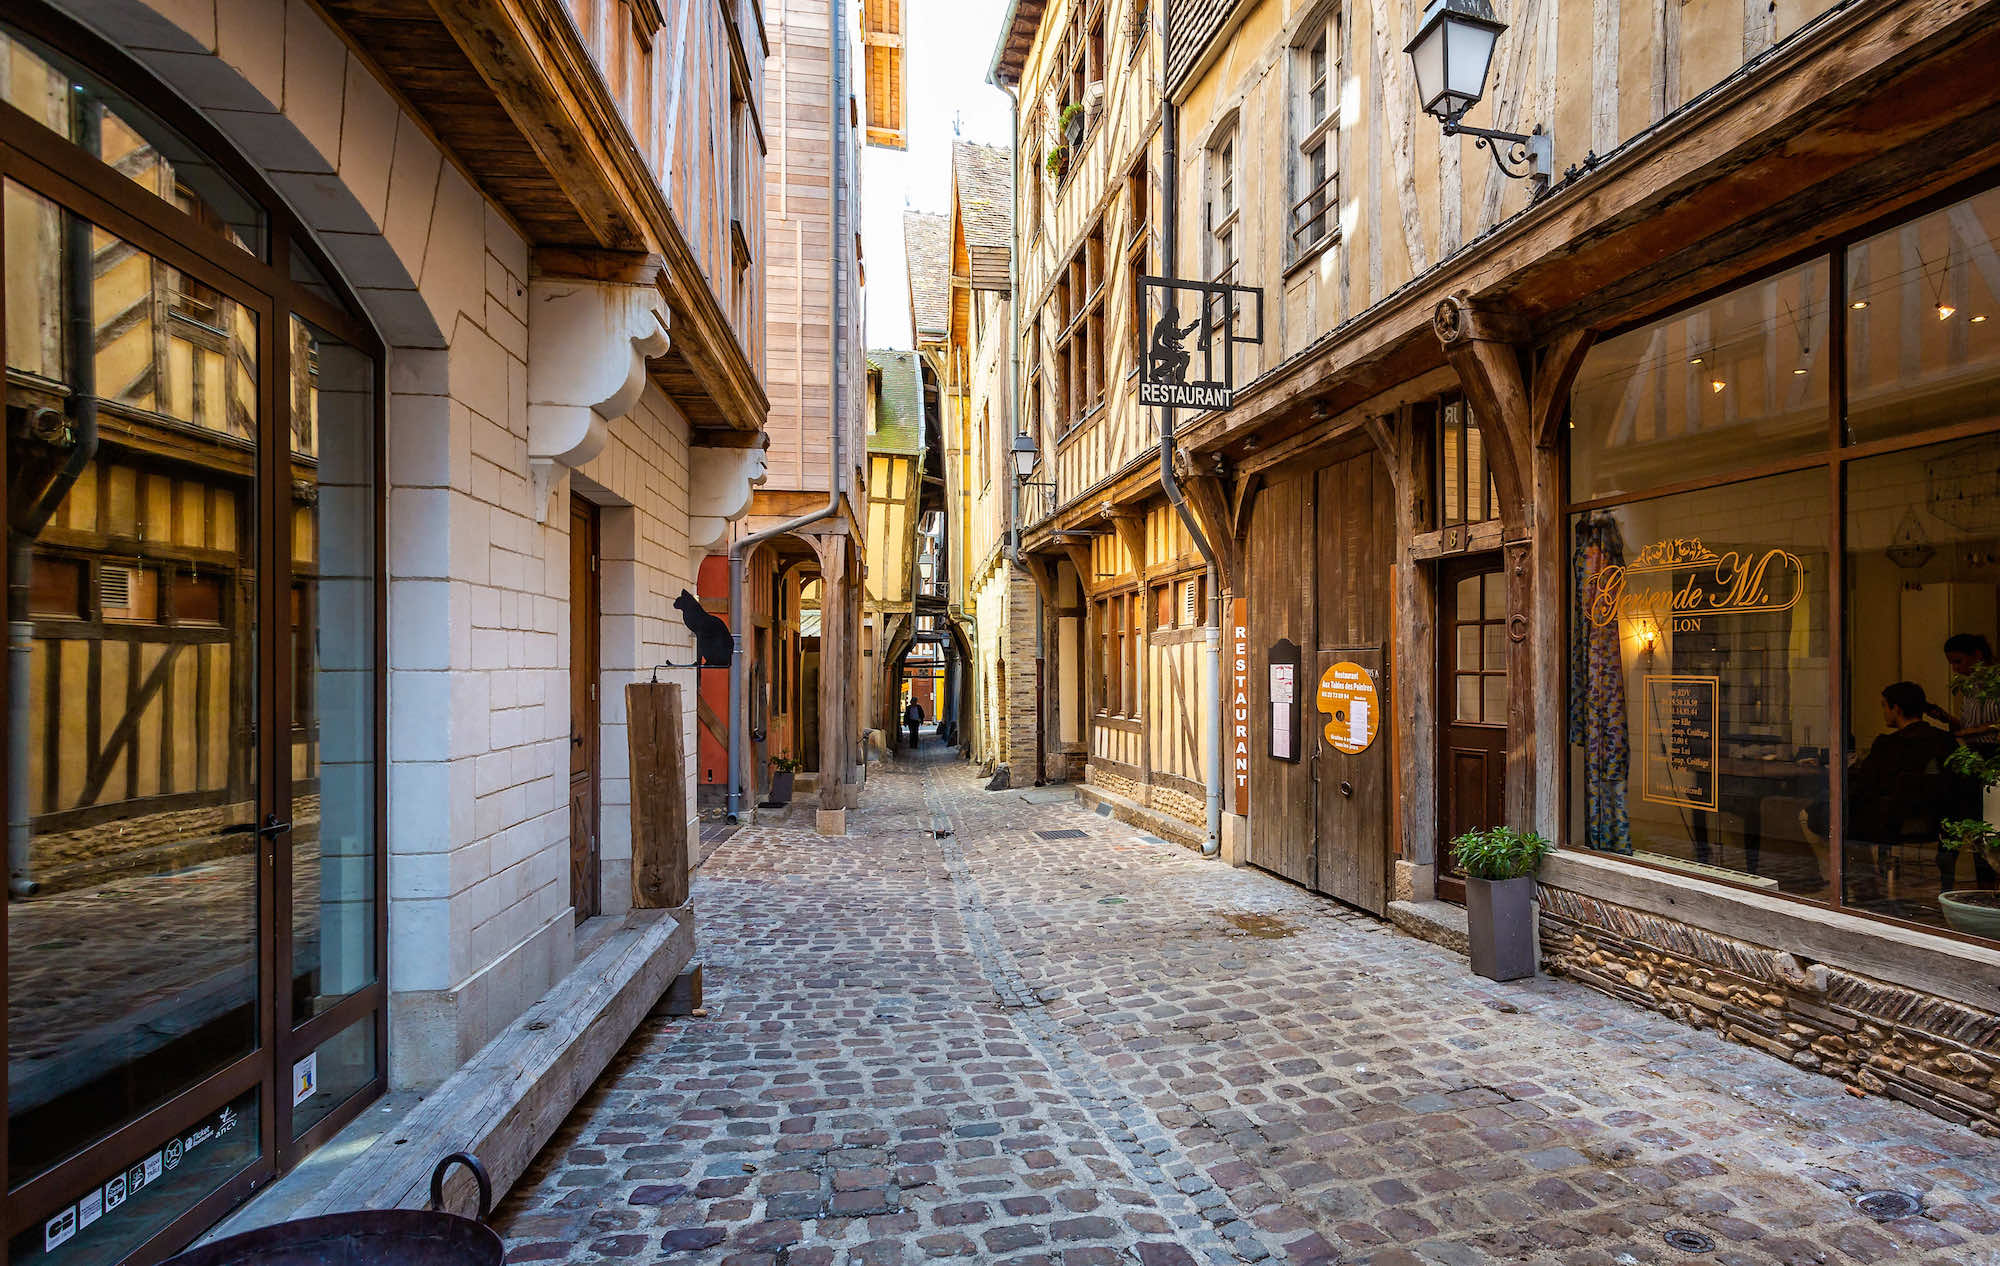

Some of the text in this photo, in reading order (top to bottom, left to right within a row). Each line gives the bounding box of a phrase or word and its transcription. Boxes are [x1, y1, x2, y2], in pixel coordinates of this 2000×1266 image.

[1141, 383, 1232, 407] RESTAURANT
[1449, 530, 1457, 547] 8
[1592, 549, 1789, 627] Gersende M.
[1331, 680, 1344, 689] Tables
[1335, 671, 1359, 680] Restaurant
[1235, 626, 1248, 787] RESTAURANT
